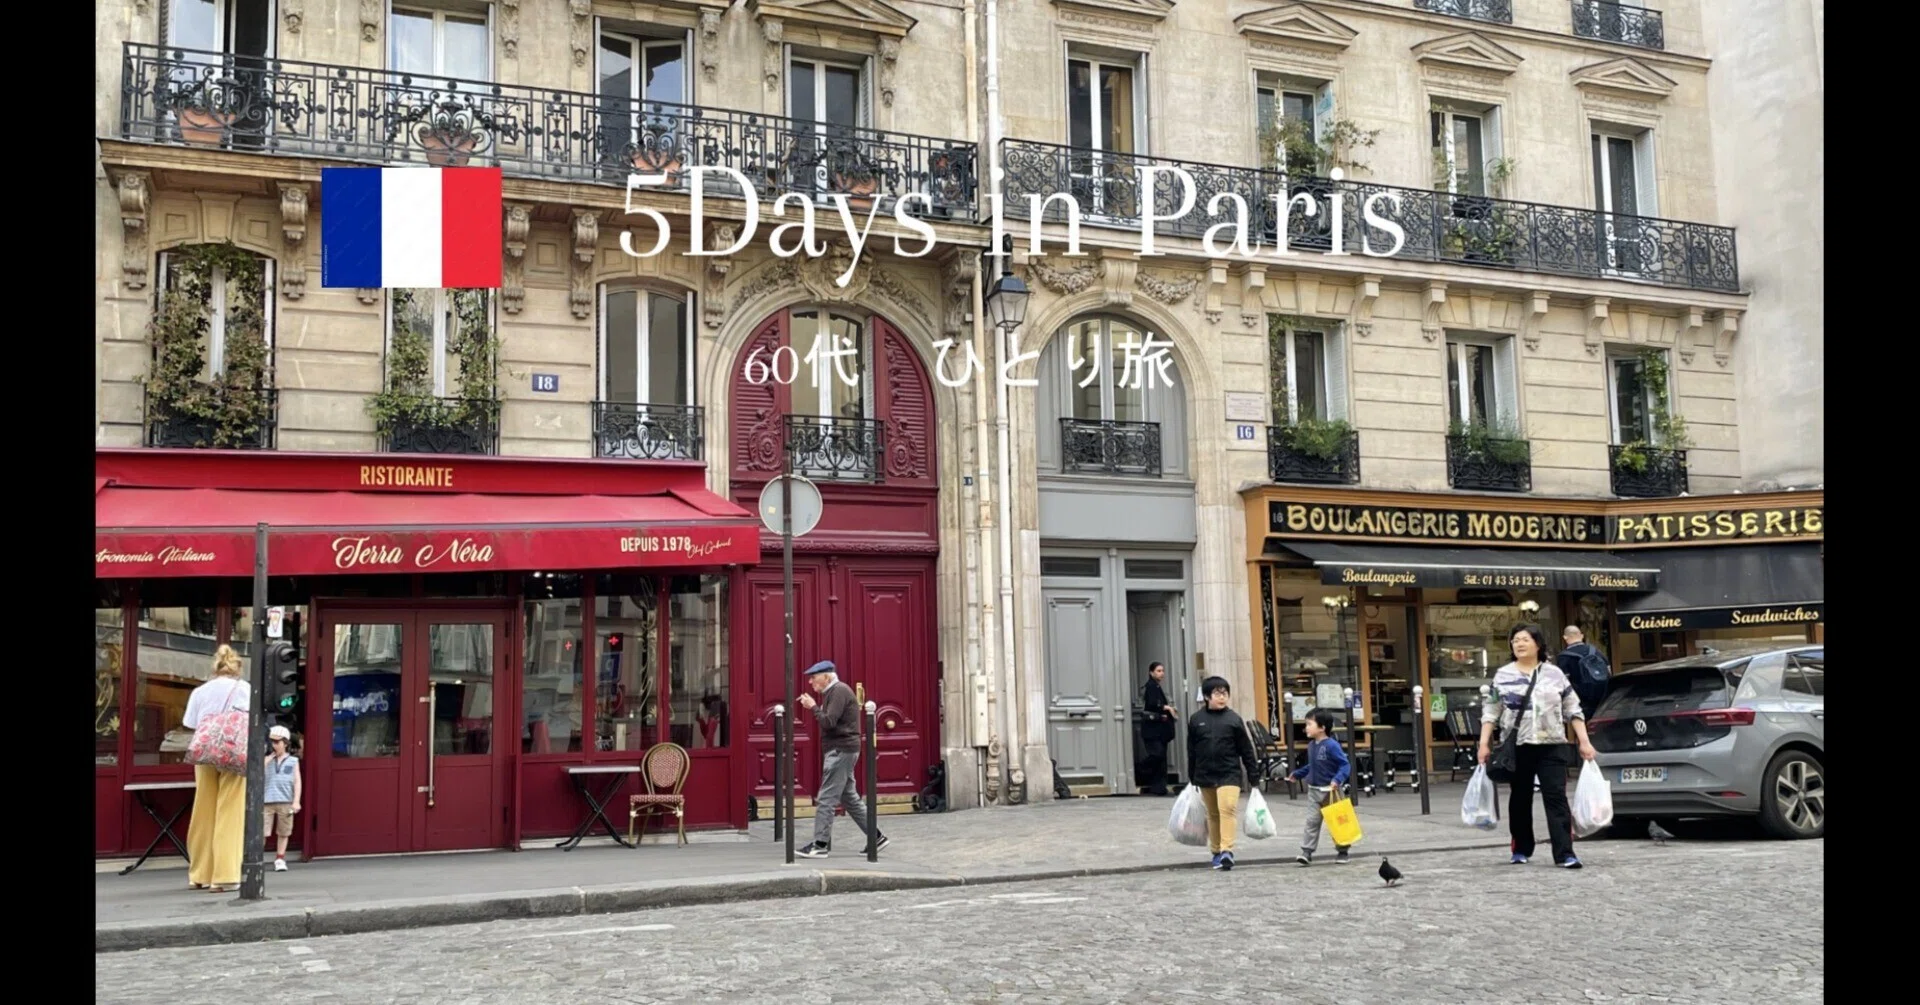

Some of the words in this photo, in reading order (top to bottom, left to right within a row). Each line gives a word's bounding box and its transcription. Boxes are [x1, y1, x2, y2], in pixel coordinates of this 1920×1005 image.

[538, 376, 553, 390] 18
[1239, 426, 1252, 439] 16
[360, 465, 453, 486] RISTORANTE
[1287, 504, 1460, 537] BOULANGERIE
[1467, 513, 1587, 541] MODERNE
[1618, 509, 1823, 540] PATISSERIE
[332, 536, 404, 568] Terra
[415, 538, 494, 567] Nera
[620, 536, 659, 552] DEPUIS
[662, 536, 691, 551] 1978
[157, 546, 216, 565] Italiana
[1342, 568, 1417, 587] Boulangerie
[1482, 575, 1492, 585] 01
[1495, 575, 1507, 585] 43
[1508, 575, 1520, 586] 54
[1522, 575, 1533, 586] 12
[1534, 576, 1546, 586] 22
[1589, 573, 1639, 588] Pâtisserie
[1630, 615, 1682, 630] Cuisine
[1731, 607, 1819, 624] Sandwiches
[1635, 769, 1649, 779] 994
